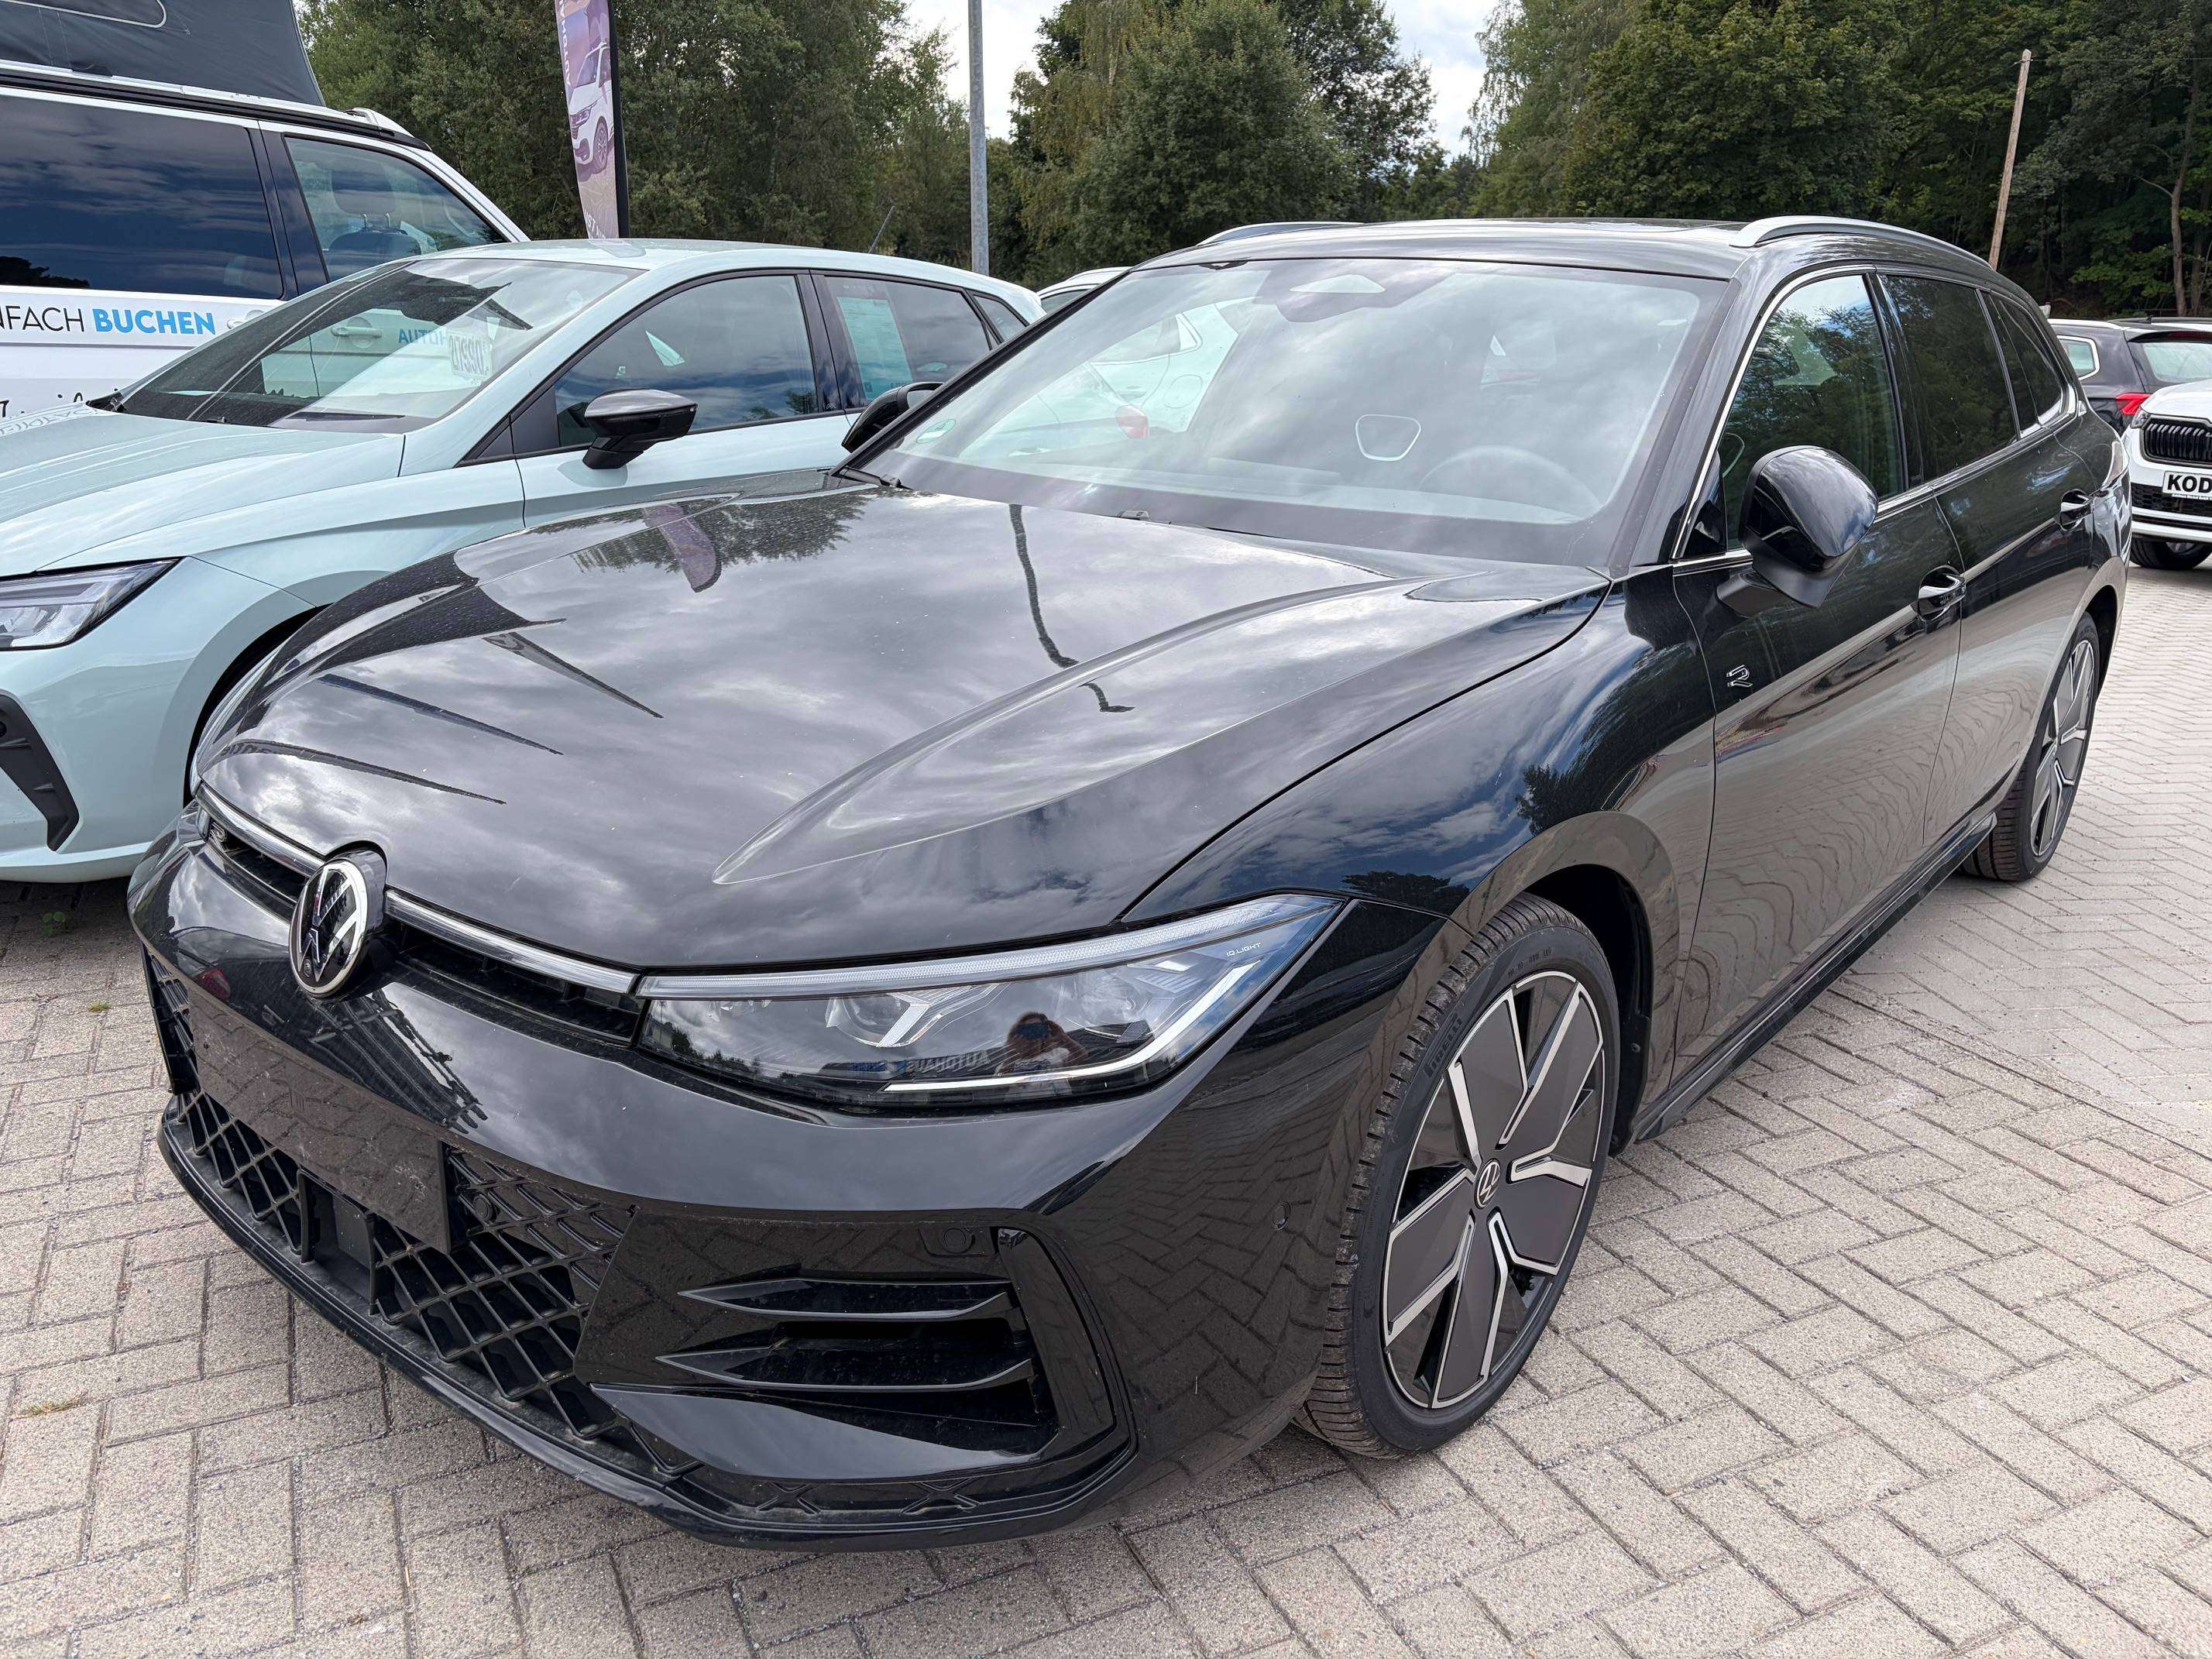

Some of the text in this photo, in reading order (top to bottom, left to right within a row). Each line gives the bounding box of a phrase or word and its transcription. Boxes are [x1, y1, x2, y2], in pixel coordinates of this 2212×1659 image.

[92, 308, 216, 335] BUCHEN
[2167, 474, 2212, 493] KOD
[1427, 1012, 1463, 1078] PIRELLI
